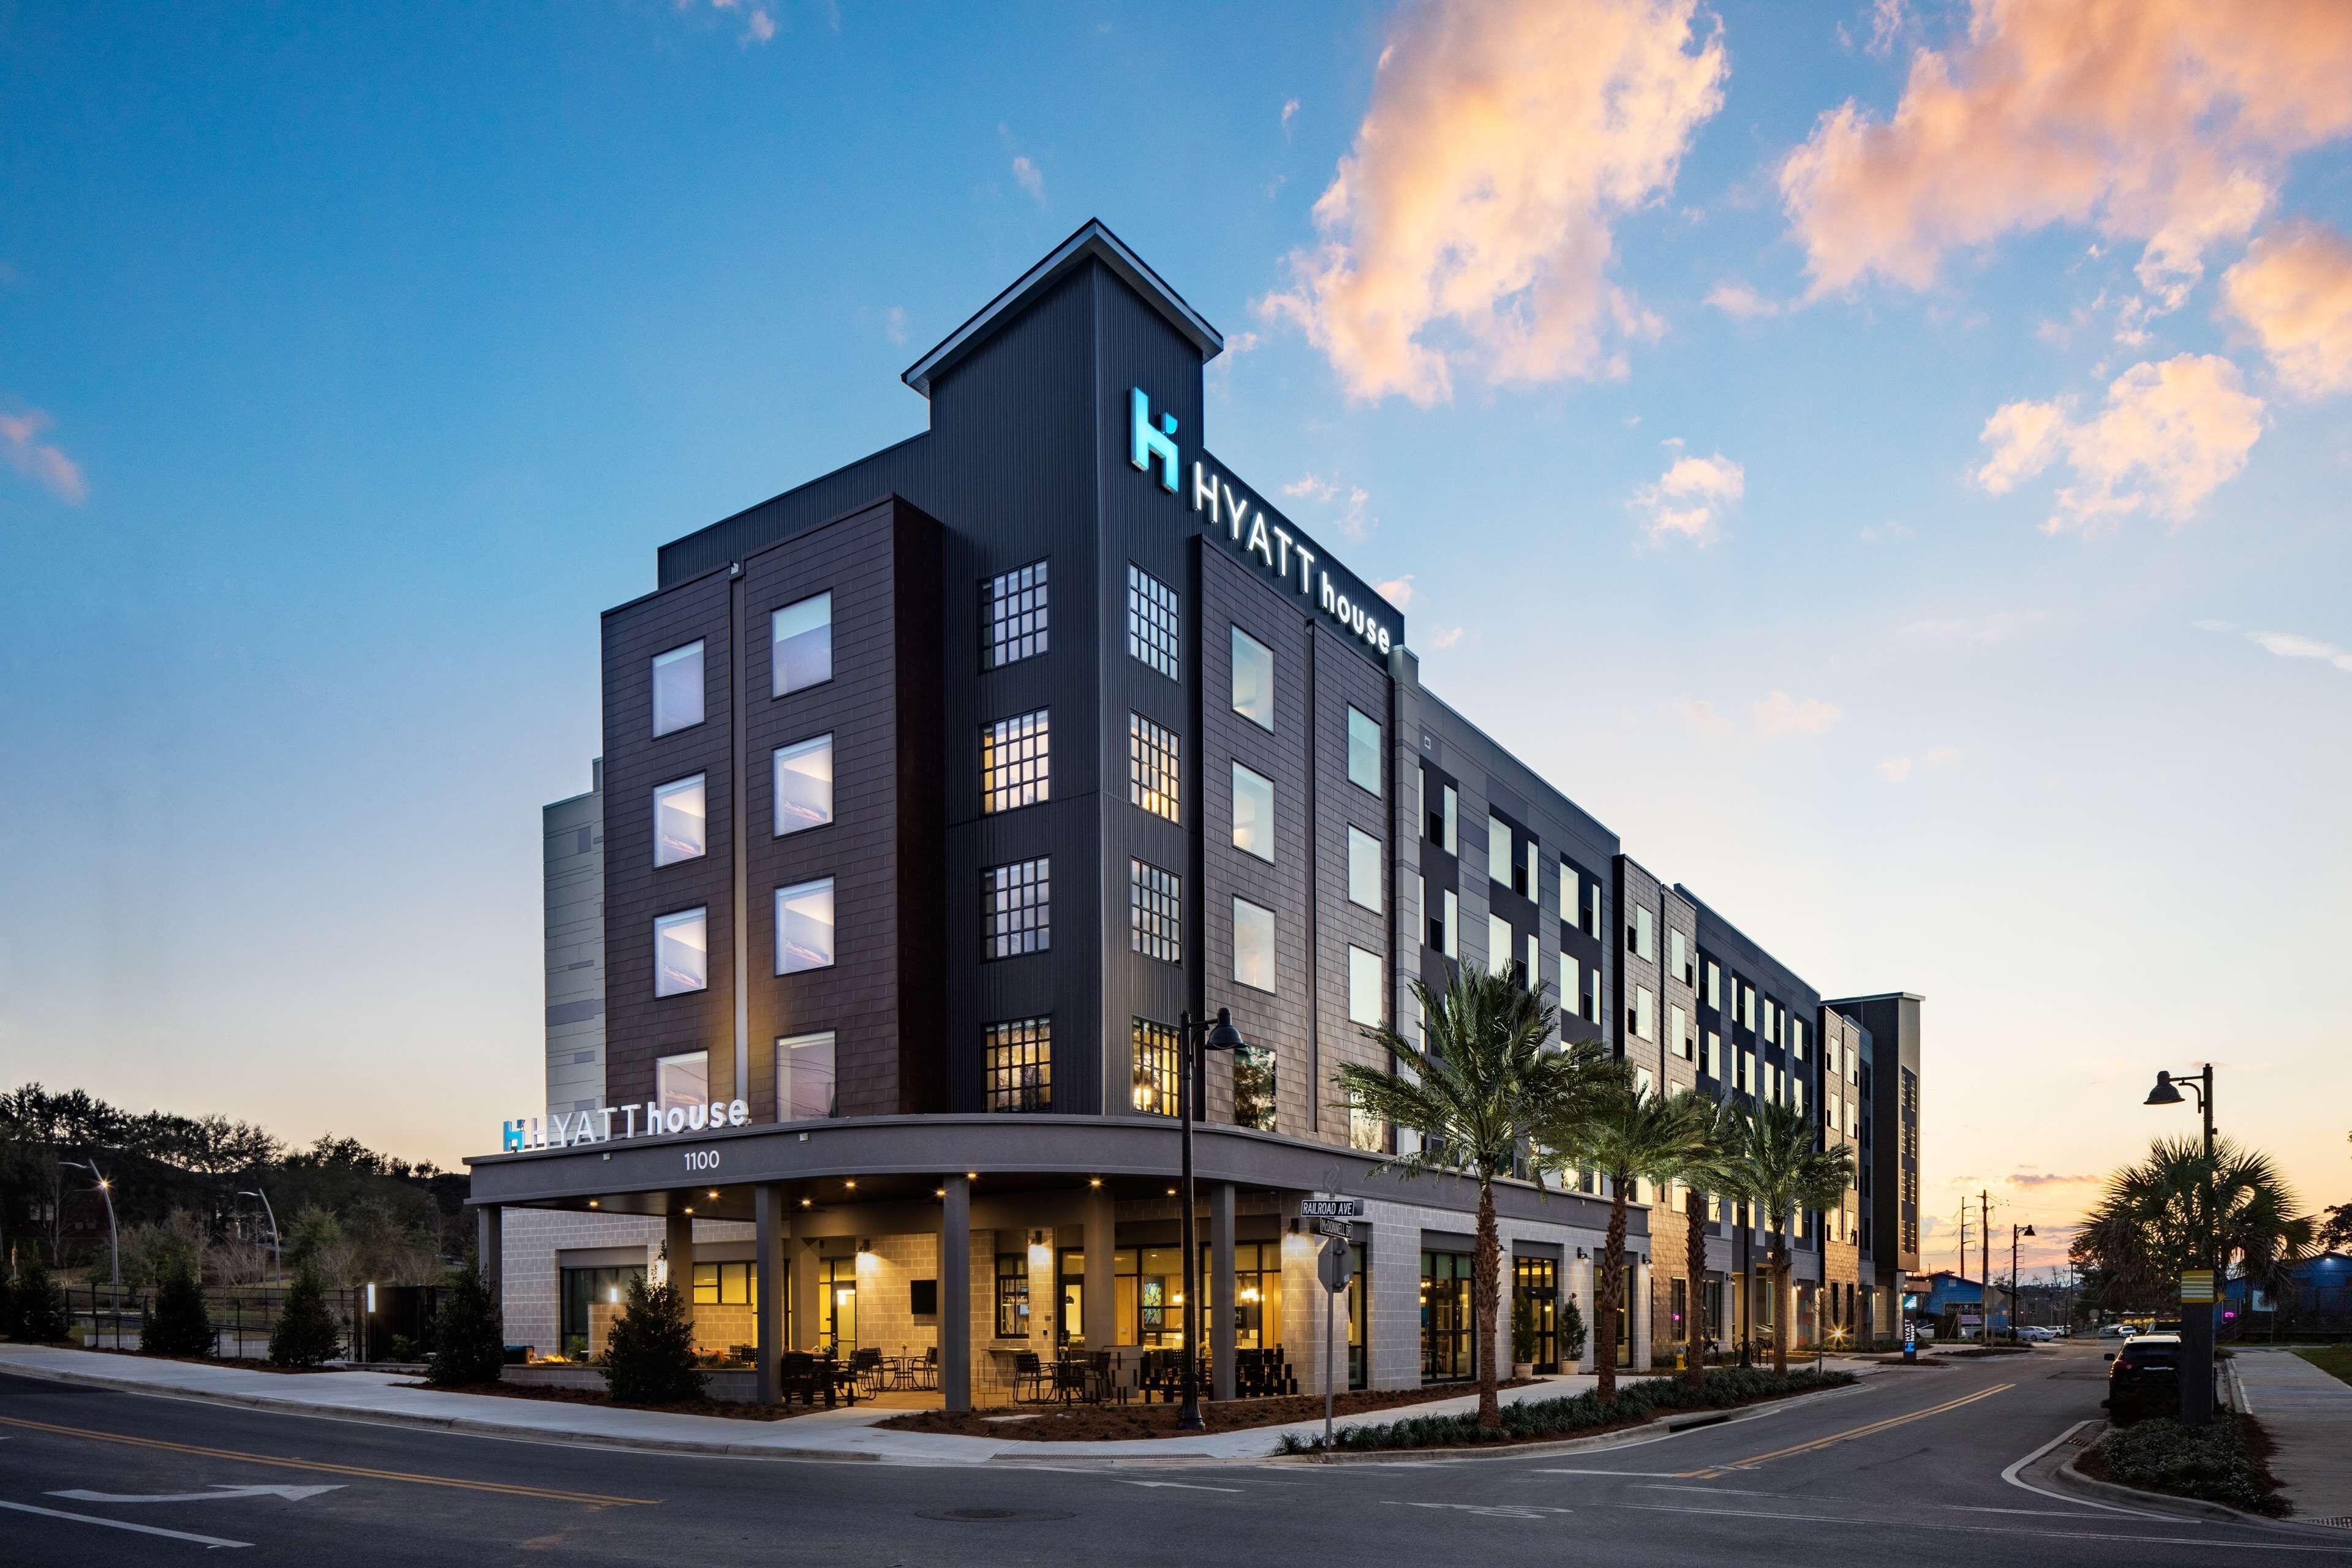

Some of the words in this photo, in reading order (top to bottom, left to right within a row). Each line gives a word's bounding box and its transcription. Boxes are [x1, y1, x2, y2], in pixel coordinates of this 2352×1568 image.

[1193, 461, 1314, 594] HYATT
[1319, 571, 1390, 655] house
[531, 1103, 641, 1150] HYATT
[647, 1098, 750, 1136] house
[684, 1150, 720, 1171] 1100
[1303, 1202, 1336, 1215] RAILROAD
[1338, 1202, 1352, 1215] AVE
[1346, 1224, 1352, 1237] DR
